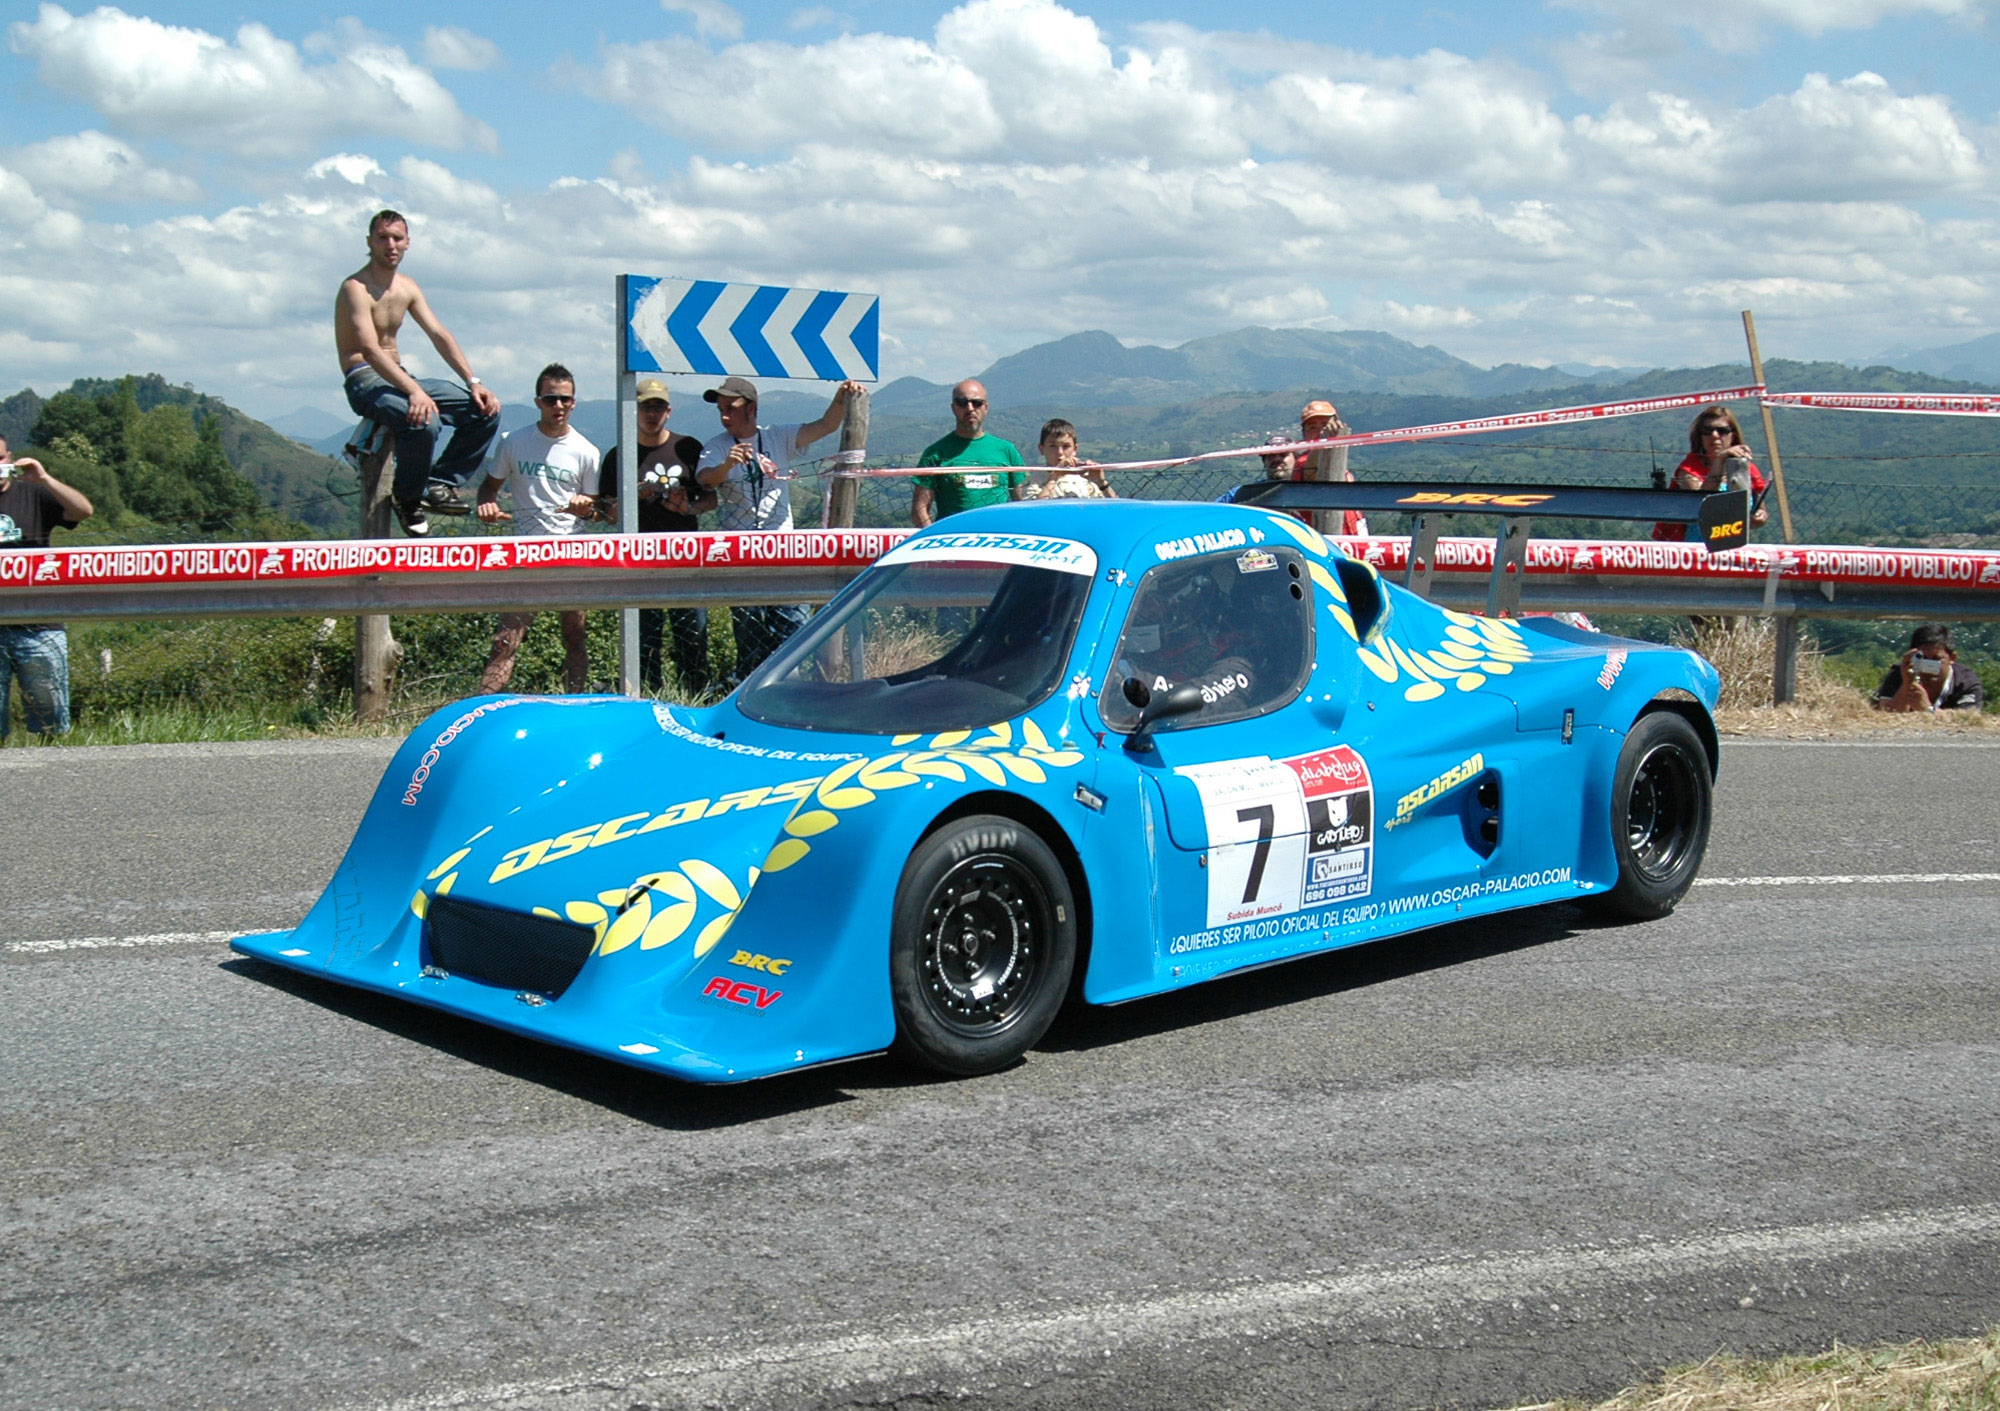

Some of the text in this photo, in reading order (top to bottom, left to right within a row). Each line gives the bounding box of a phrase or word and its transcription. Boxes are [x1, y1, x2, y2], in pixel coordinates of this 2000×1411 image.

[1810, 395, 1899, 409] PROHIBIDO
[1396, 492, 1556, 507] BRC
[1710, 521, 1743, 539] BRC
[514, 537, 698, 564] PROHIBIDO PUBLICO
[739, 535, 838, 560] PROHIBIDO
[1155, 537, 1198, 560] OSCAR
[1194, 528, 1246, 553] PALACIO
[67, 549, 251, 578] PROHIBIDO PUBLICO
[292, 545, 475, 573] PROHIBIDO PUBLICO
[1602, 546, 1768, 573] PROHIBIDO PUBLICO
[1806, 551, 1972, 580] PROHIBIDO PUBLICO
[1236, 804, 1275, 904] 7
[1306, 889, 1326, 902] 696
[1327, 885, 1347, 898] 098
[1347, 881, 1367, 894] 042
[1169, 930, 1221, 954] ¿QUIERES
[1222, 926, 1242, 945] SER
[1243, 919, 1280, 941] PILOTO
[1281, 914, 1320, 935] OFICIAL
[1322, 910, 1340, 928] DEL
[1342, 903, 1379, 925] EQUIPO
[1388, 867, 1571, 914] WWW.OSCAR-PALACIO.COM
[1227, 909, 1255, 921] Subida
[728, 950, 793, 976] BRC
[702, 976, 782, 1010] ACV
